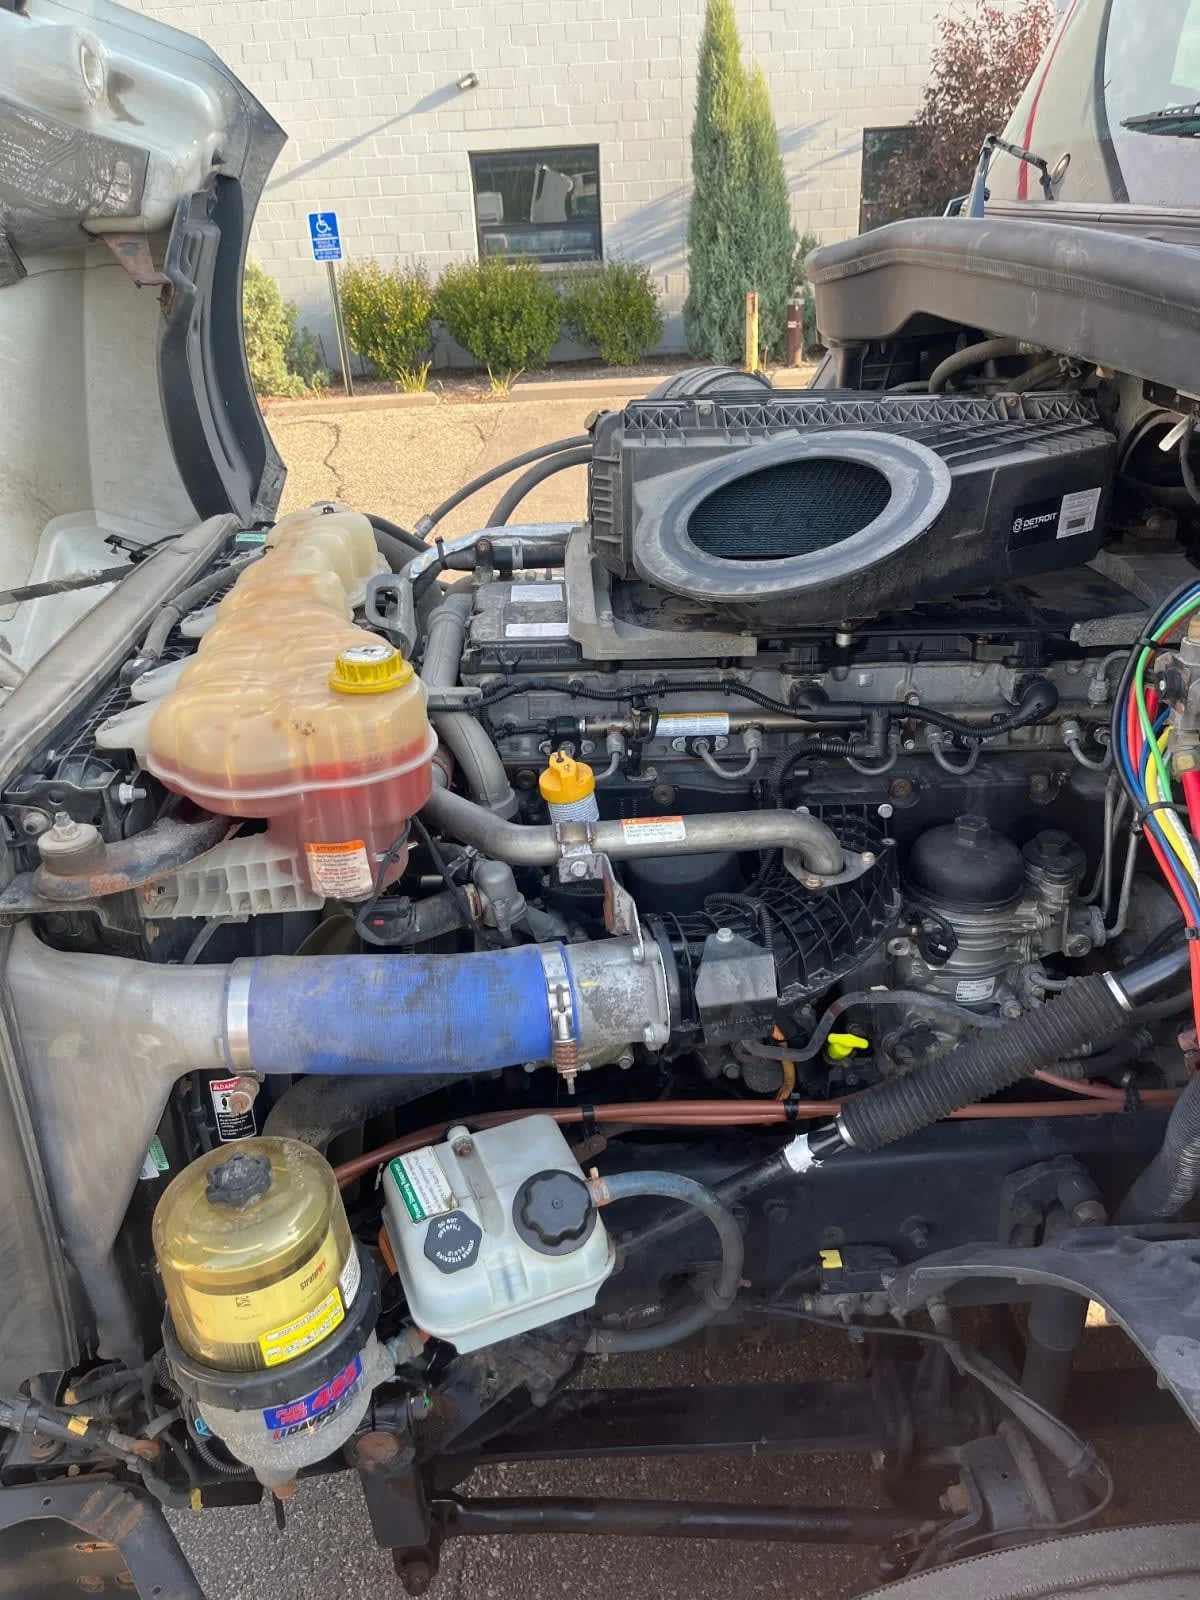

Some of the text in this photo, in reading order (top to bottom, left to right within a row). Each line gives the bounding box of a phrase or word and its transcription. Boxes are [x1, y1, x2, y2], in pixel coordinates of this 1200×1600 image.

[1023, 512, 1058, 527] DETROIT
[438, 1217, 458, 1228] DO NOT
[436, 1239, 475, 1263] POWER STEERING
[287, 1405, 336, 1435] DAVCO
